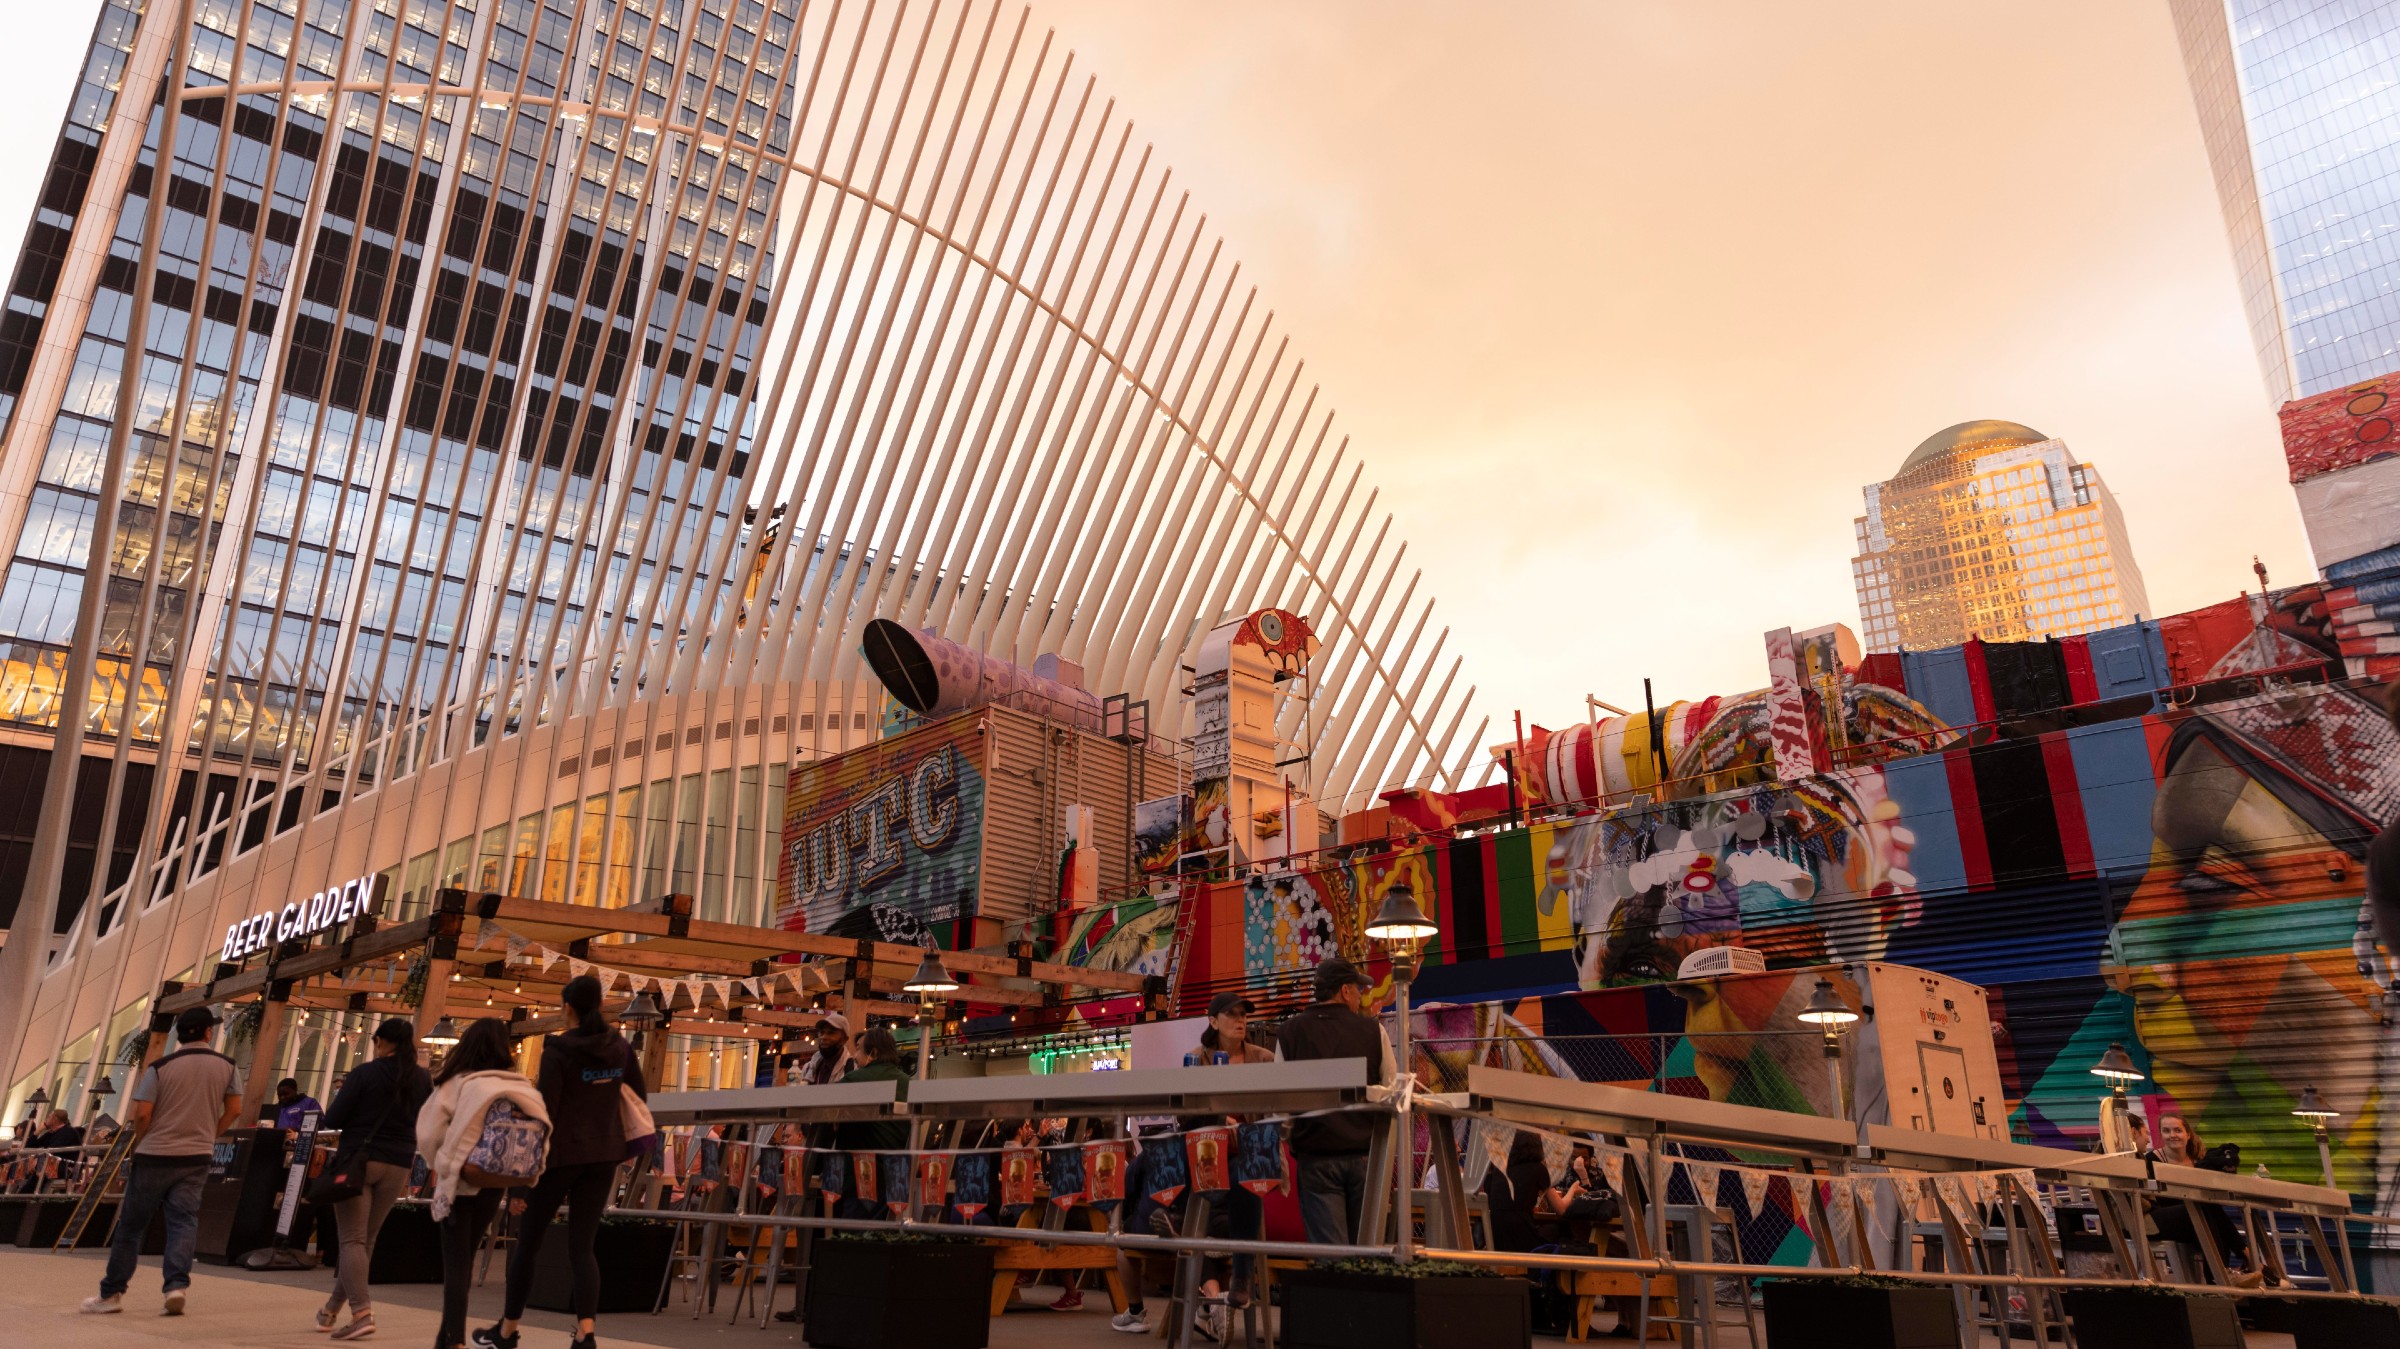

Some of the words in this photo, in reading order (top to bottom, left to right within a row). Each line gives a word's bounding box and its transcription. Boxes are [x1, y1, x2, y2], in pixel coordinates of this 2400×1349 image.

[790, 742, 957, 905] WTC
[220, 910, 274, 962] BEER
[276, 871, 376, 943] GARDEN
